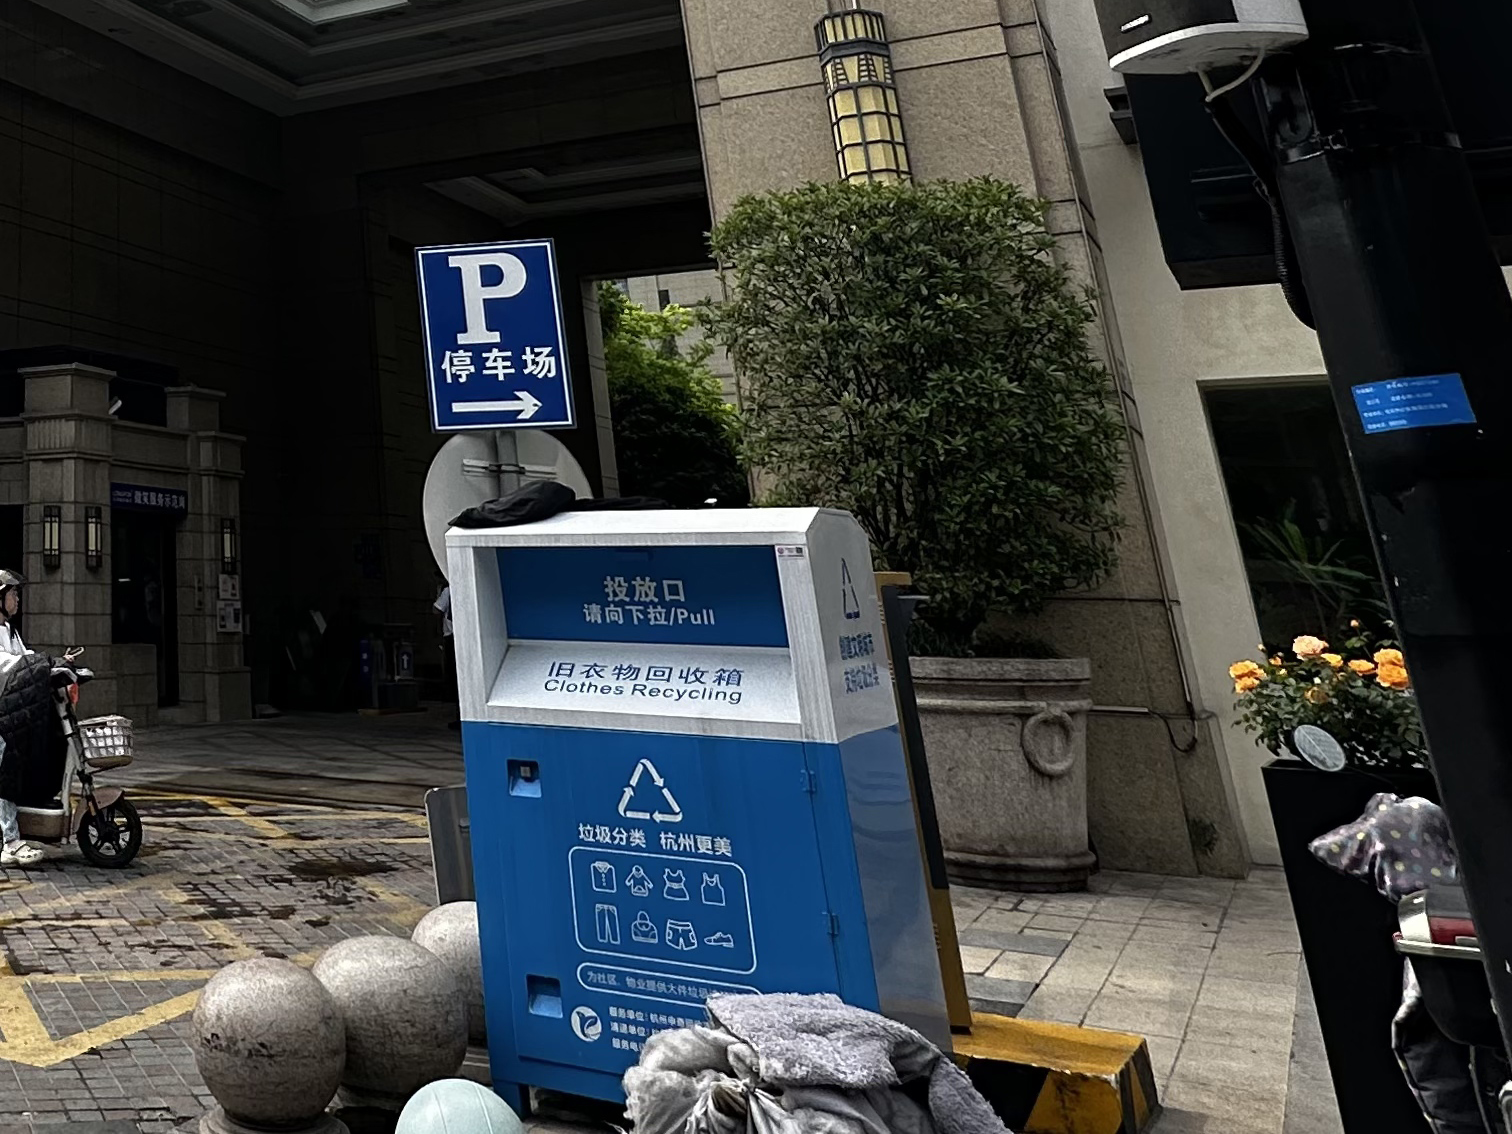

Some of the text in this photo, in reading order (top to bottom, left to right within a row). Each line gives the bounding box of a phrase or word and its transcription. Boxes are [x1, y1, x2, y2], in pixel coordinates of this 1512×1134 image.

[448, 252, 527, 345] P
[441, 347, 556, 384] 停车场
[603, 575, 686, 602] 投放口
[583, 604, 715, 626] 请向下拉/Pull
[548, 661, 745, 687] 旧衣物回收箱
[544, 679, 743, 705] Clothes Recycling
[578, 823, 732, 857] 垃圾分类 杭州更美
